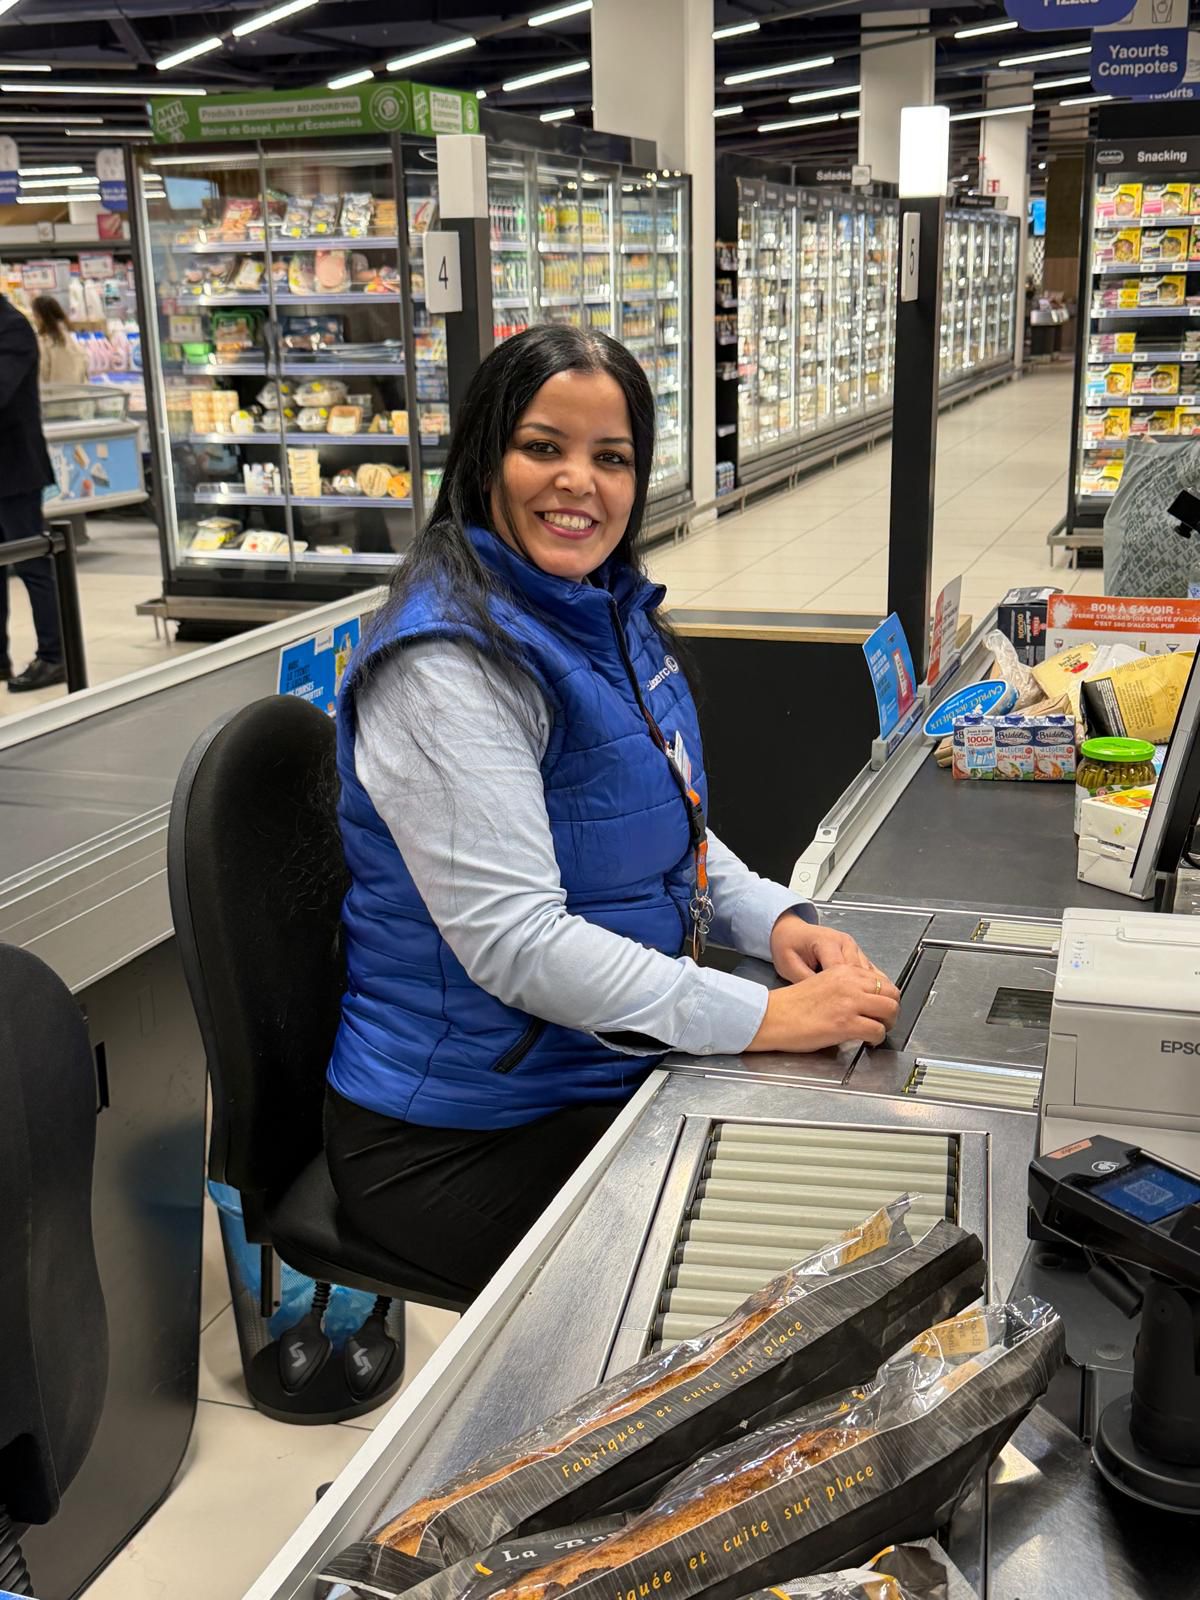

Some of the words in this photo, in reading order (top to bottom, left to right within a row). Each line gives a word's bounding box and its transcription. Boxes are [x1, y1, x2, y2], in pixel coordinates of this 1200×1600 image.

[1109, 44, 1169, 59] Yaourts
[1098, 60, 1178, 78] Compotes
[157, 100, 182, 120] ANTI
[202, 108, 234, 119] Produits
[238, 107, 244, 117] à
[245, 105, 295, 116] consommer
[296, 101, 359, 113] AUJOURD'HUI
[201, 125, 228, 136] Moins
[229, 124, 241, 135] de
[275, 120, 295, 135] plus
[1137, 149, 1188, 164] Snacking
[816, 170, 852, 182] Salades
[908, 238, 915, 276] 5
[437, 256, 448, 290] 4
[1091, 603, 1116, 613] BON
[1119, 602, 1128, 613] À
[1129, 604, 1174, 615] SAVOIR
[561, 1420, 645, 1479] Fabriquée
[656, 1406, 672, 1418] et
[683, 1380, 722, 1403] cuite
[731, 1358, 754, 1380] sur
[763, 1320, 804, 1357] place
[688, 1550, 708, 1570] et
[723, 1520, 769, 1552] cuite
[784, 1495, 812, 1520] sur
[825, 1464, 875, 1502] place
[502, 1549, 538, 1562] La
